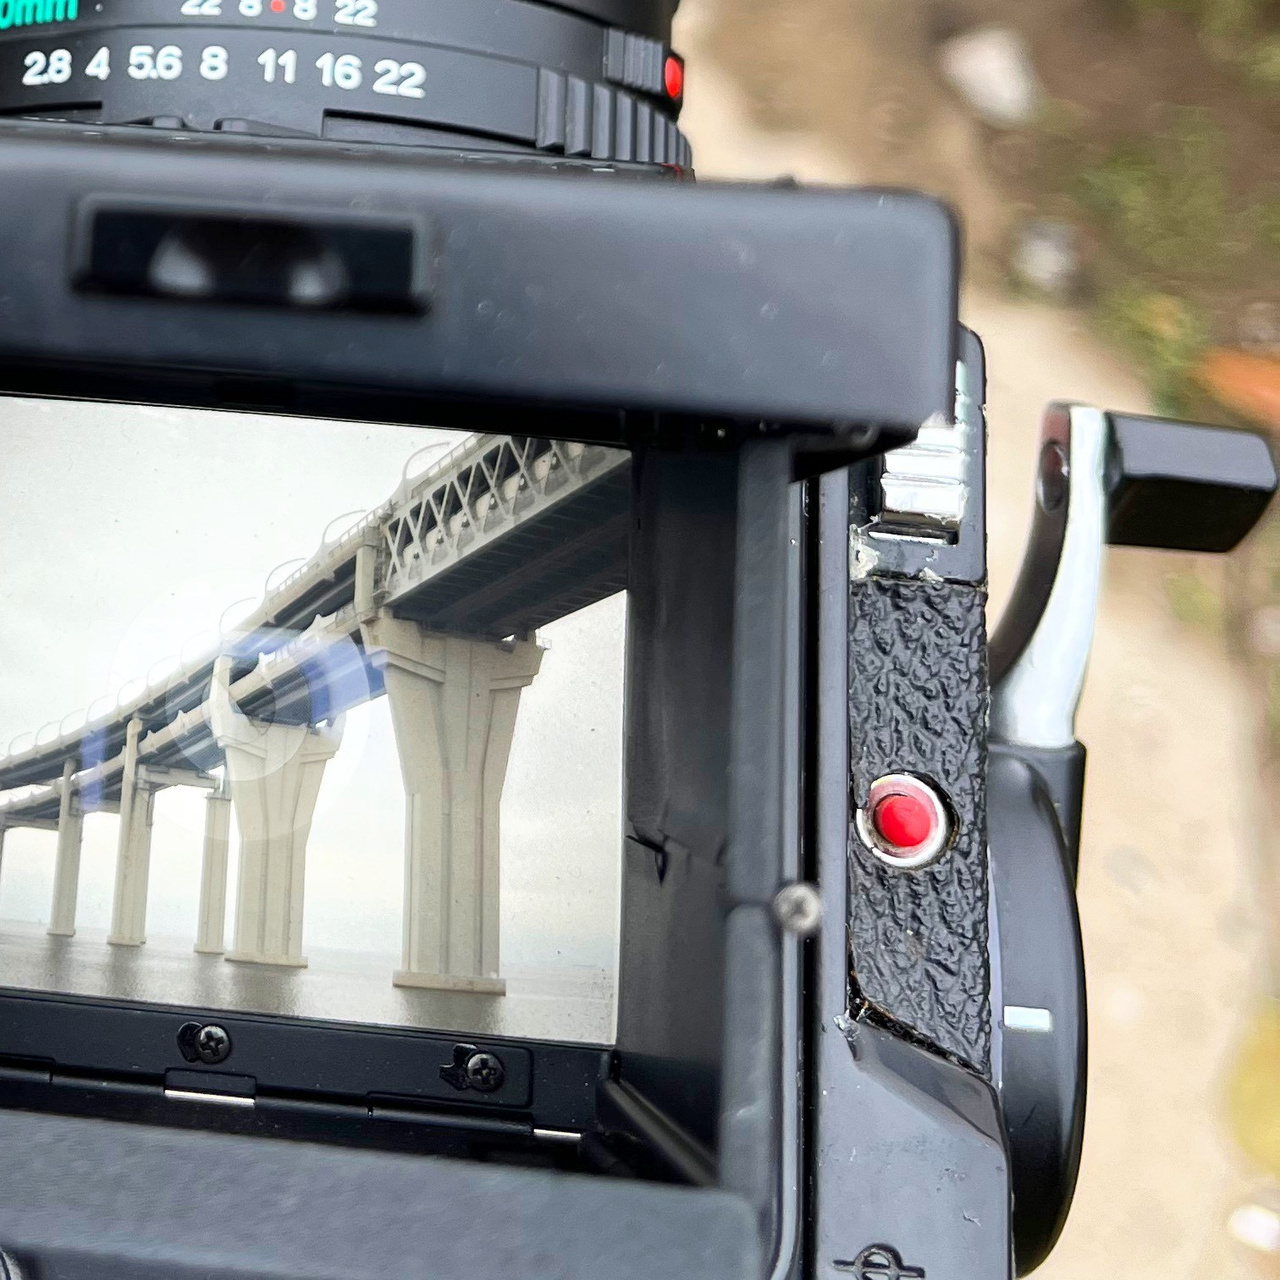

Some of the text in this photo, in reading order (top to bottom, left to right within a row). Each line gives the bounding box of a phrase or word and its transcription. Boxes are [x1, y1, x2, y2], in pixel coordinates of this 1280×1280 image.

[84, 46, 112, 81] 4
[127, 44, 183, 80] 5.6
[199, 45, 229, 81] 8
[257, 47, 298, 84] 11
[315, 51, 363, 90] 16
[372, 58, 427, 99] 22
